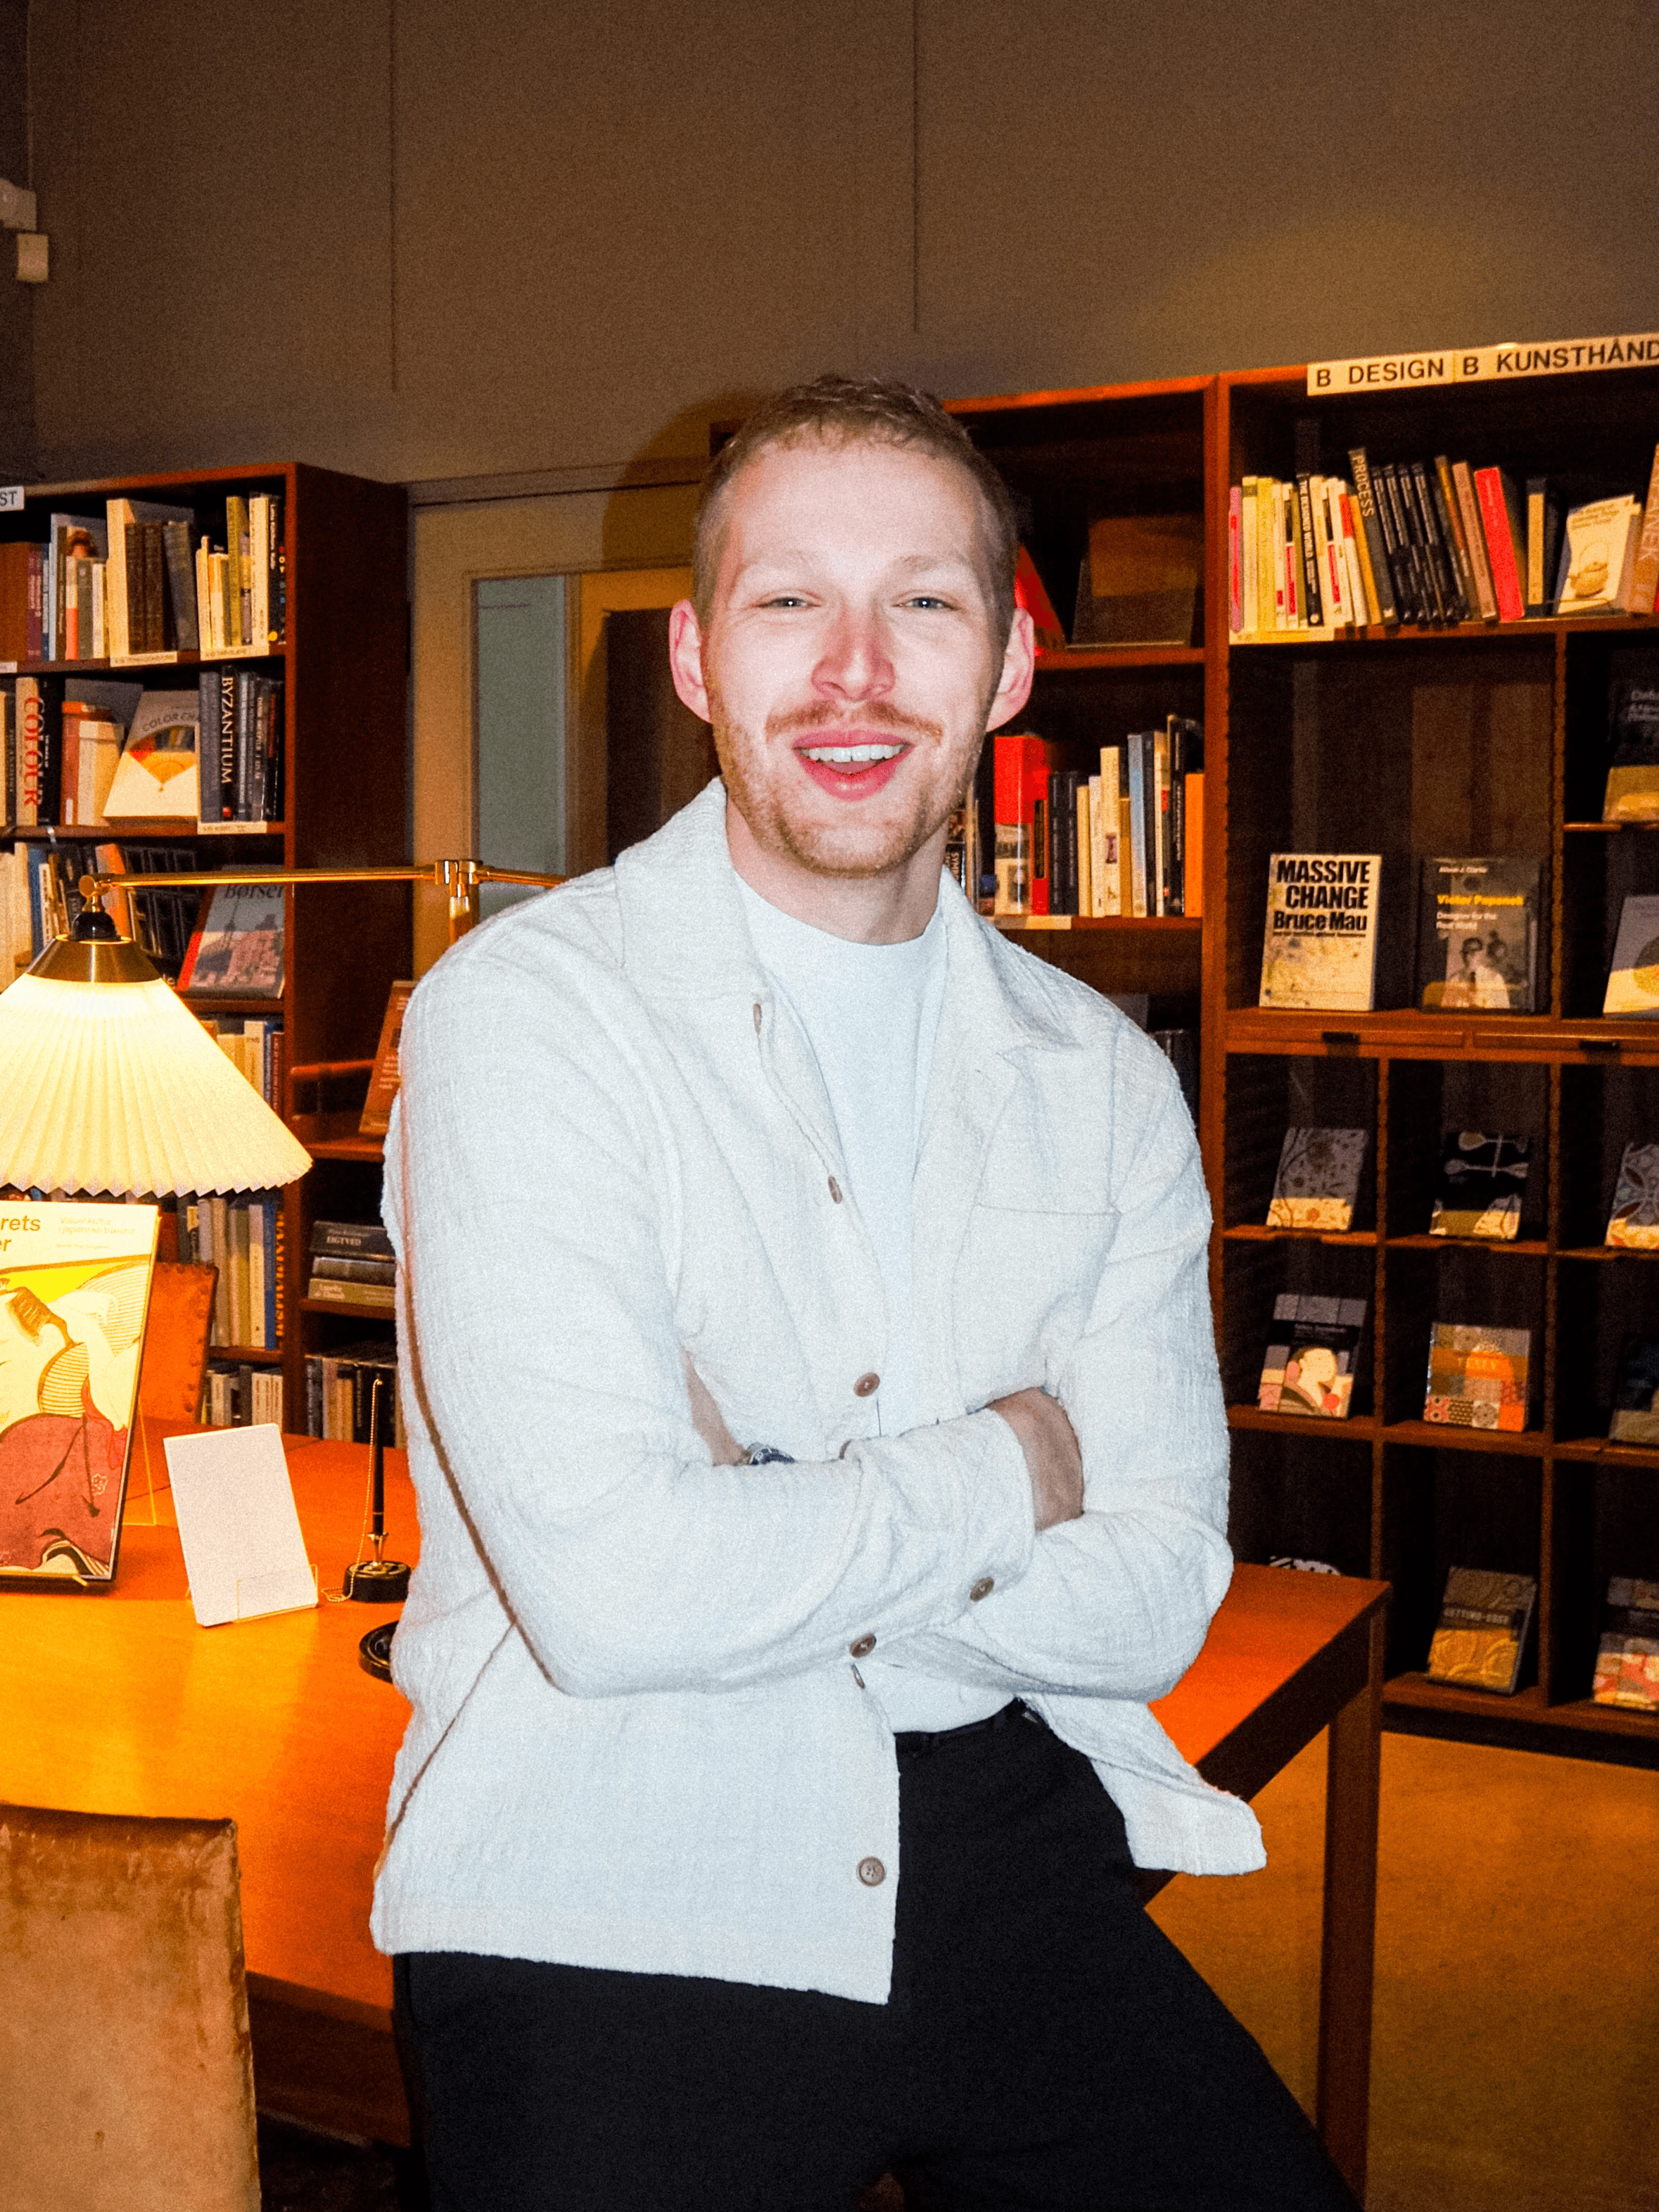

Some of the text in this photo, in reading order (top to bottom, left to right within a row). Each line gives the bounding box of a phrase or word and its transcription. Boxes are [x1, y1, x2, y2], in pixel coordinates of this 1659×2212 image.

[1463, 338, 1659, 375] B KUNSTHÅND
[1316, 358, 1443, 387] B DESIGN
[1351, 455, 1375, 517] PROCESS
[143, 712, 179, 732] COLOR
[221, 677, 234, 784] BYZANTIUM
[23, 697, 44, 806] COLOUR
[1277, 860, 1371, 884] MASSIVE
[1285, 885, 1369, 909] CHANGE
[1273, 910, 1367, 931] Bruce Mau
[1, 1215, 41, 1231] rets
[275, 1211, 284, 1336] MAXIMALISM
